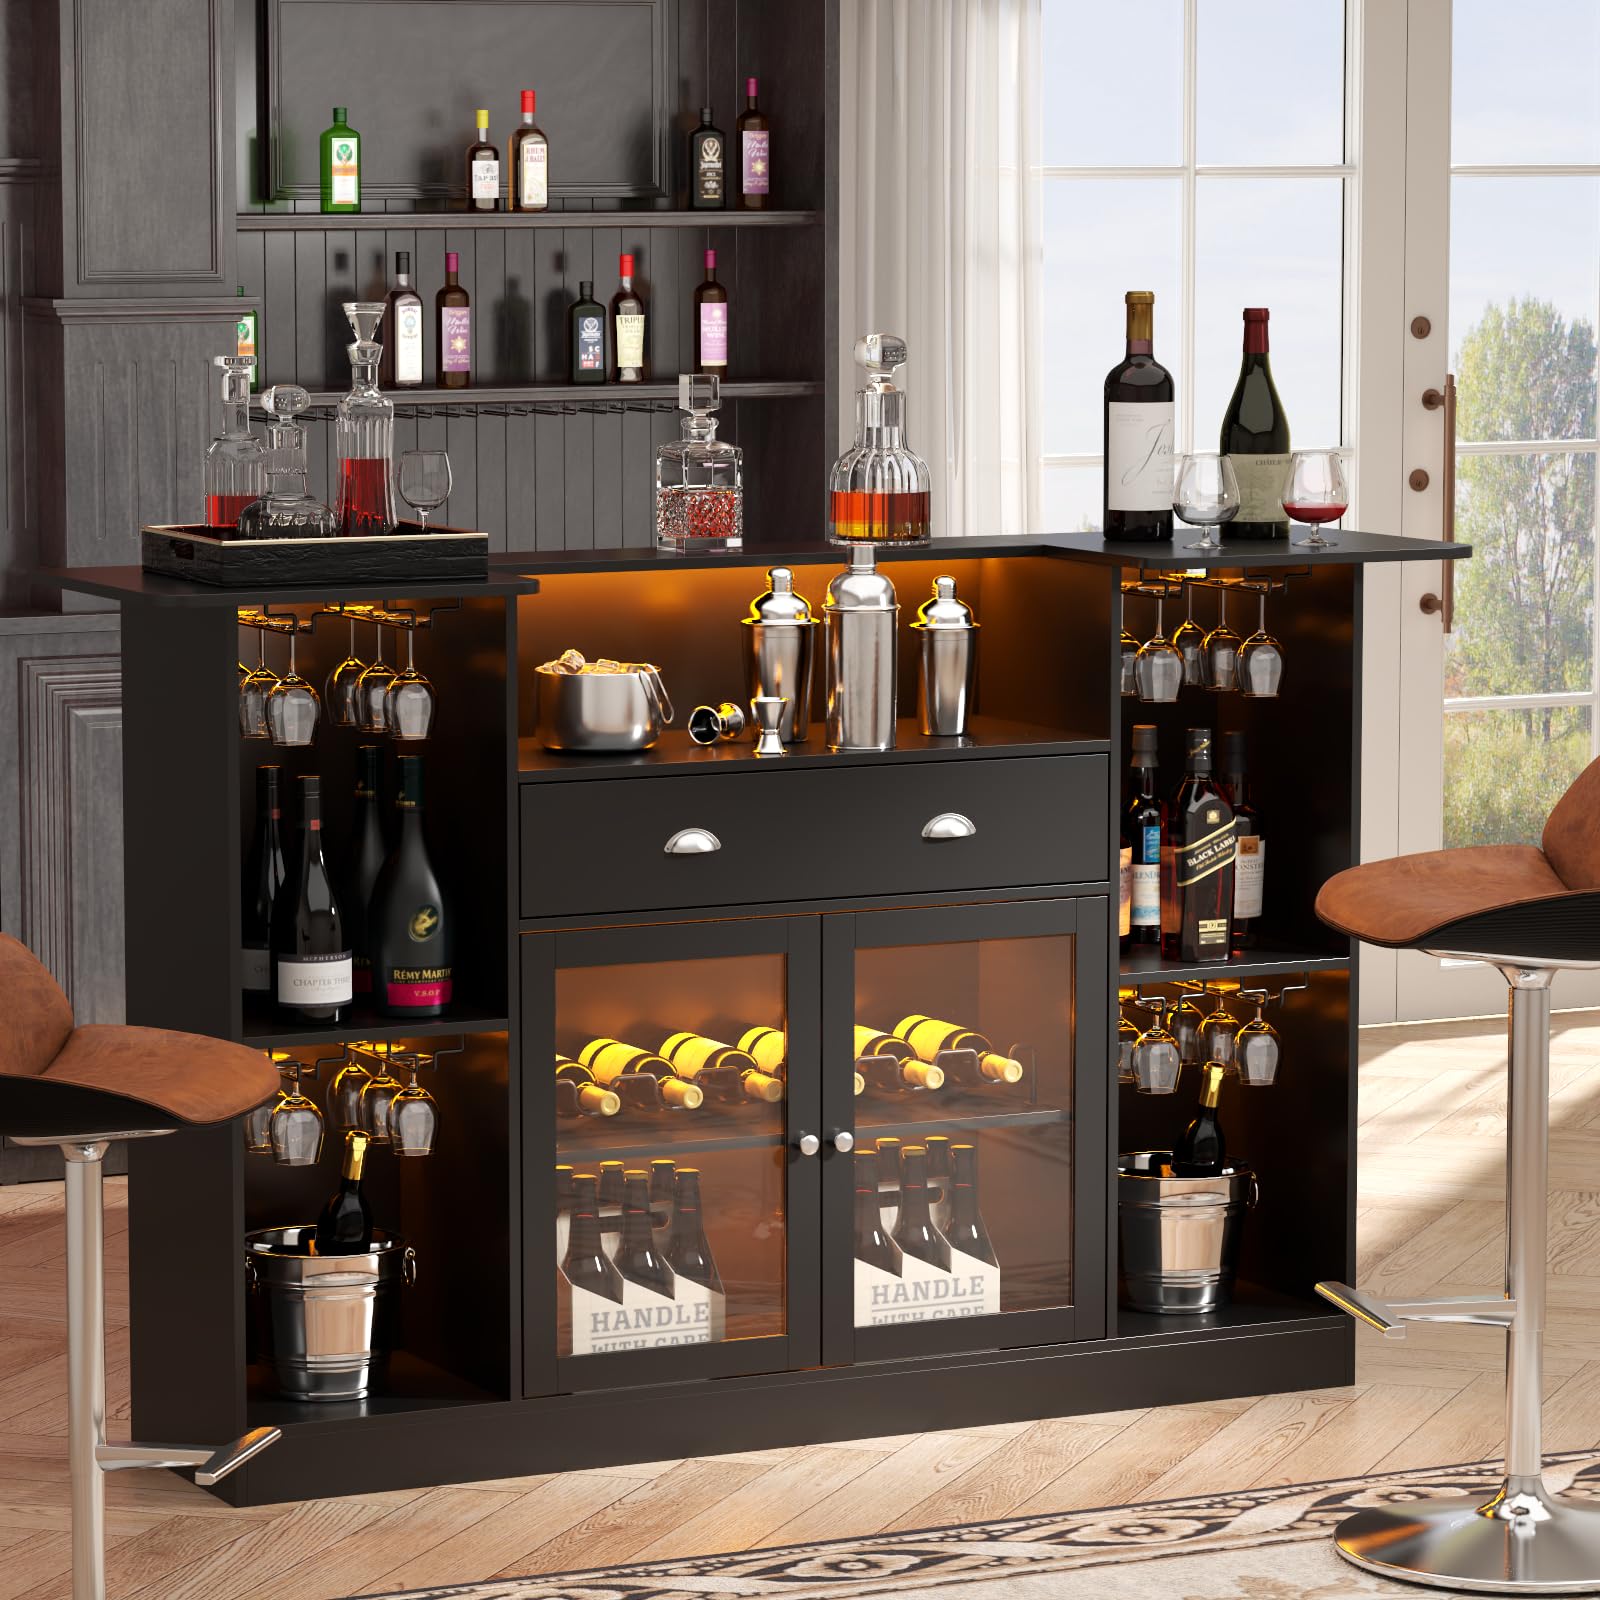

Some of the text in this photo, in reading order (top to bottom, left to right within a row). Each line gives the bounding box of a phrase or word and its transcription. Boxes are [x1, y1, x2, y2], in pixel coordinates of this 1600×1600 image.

[1187, 834, 1236, 867] BLACK LABEL
[293, 976, 334, 987] CHAPTER
[393, 968, 420, 980] RÉMY
[421, 967, 452, 980] MARTIN
[872, 1275, 985, 1306] HANDLE
[591, 1302, 709, 1333] HANDLE
